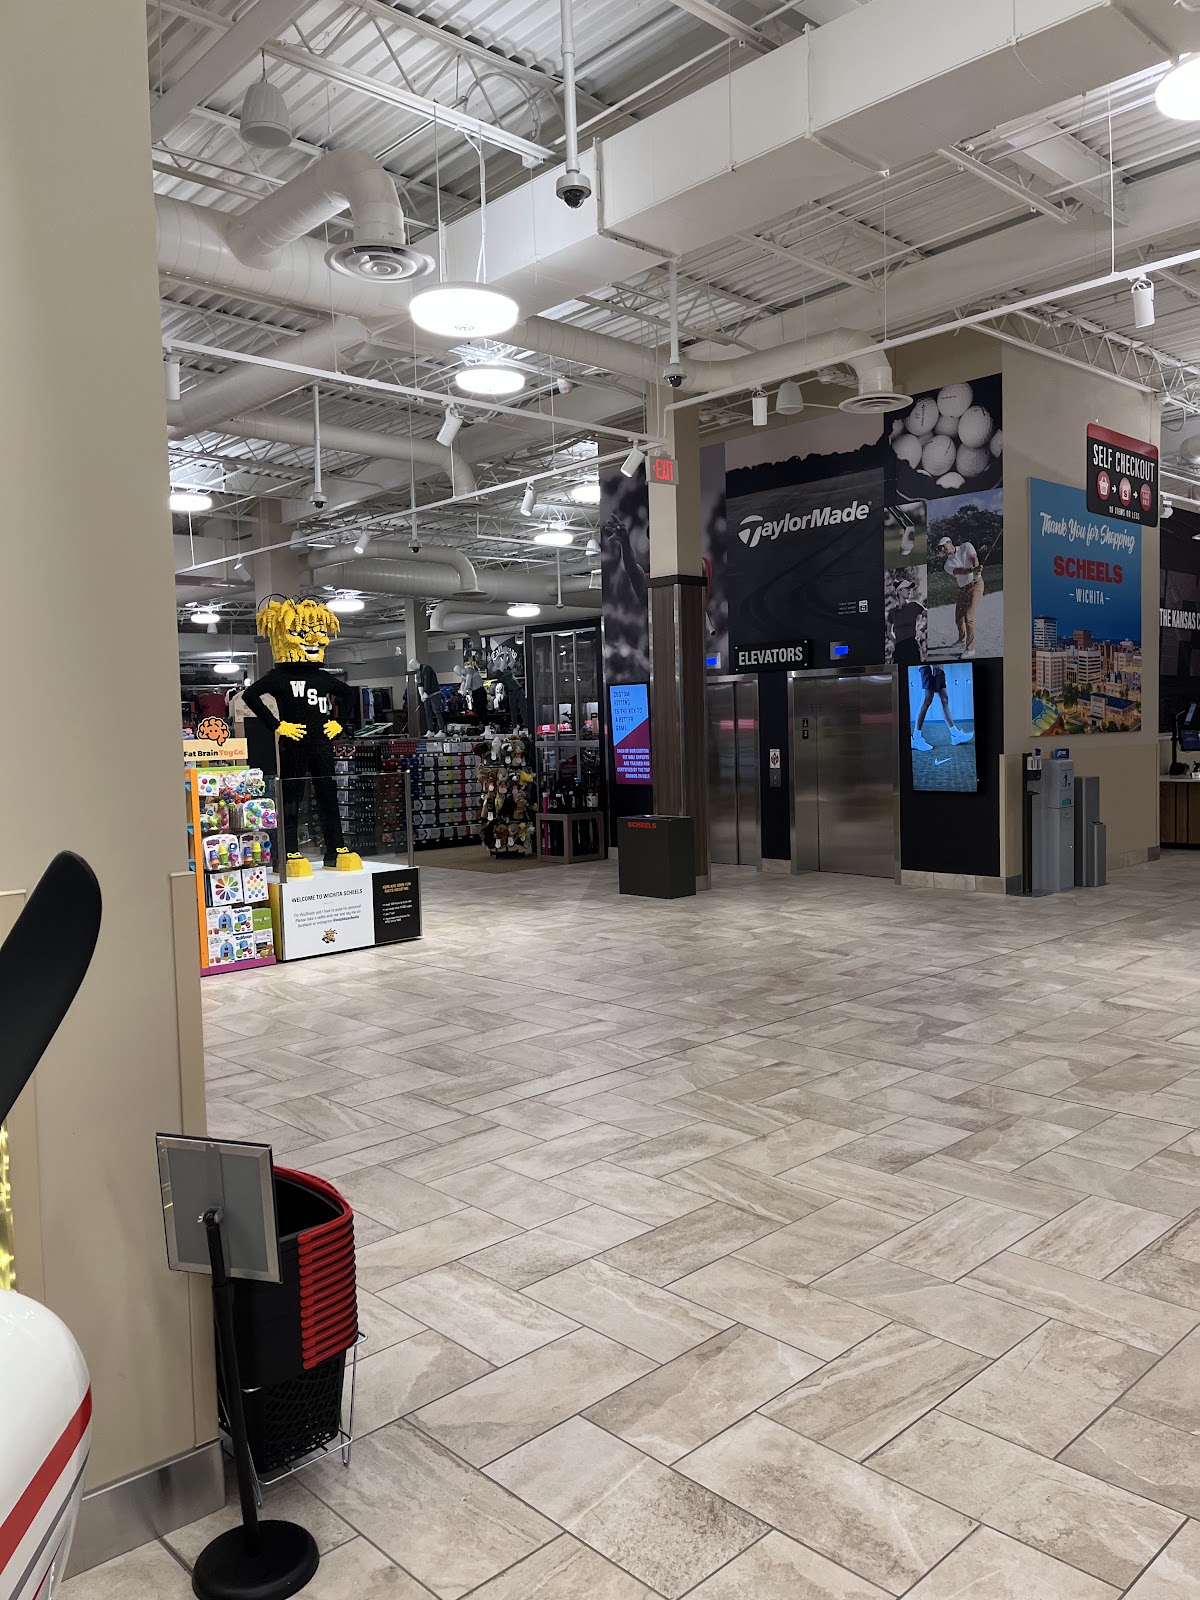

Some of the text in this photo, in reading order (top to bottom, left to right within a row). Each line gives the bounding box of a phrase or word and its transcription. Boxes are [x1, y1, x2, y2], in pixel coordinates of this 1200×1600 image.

[656, 458, 673, 481] EXIT
[1093, 444, 1155, 482] SELF CHECKOUT
[738, 500, 870, 547] TaylorMade
[1115, 507, 1125, 516] ITEMS
[1126, 510, 1131, 518] OR
[1132, 511, 1140, 520] LESS
[1040, 512, 1135, 554] Thank You for Shopping
[1053, 555, 1123, 584] SCHEELS
[1075, 588, 1104, 605] WICHITA
[1160, 608, 1171, 627] THE
[1172, 610, 1196, 630] KANSAS
[738, 646, 803, 666] ELEVATORS
[290, 680, 327, 714] WSU
[291, 895, 315, 903] WELCOME
